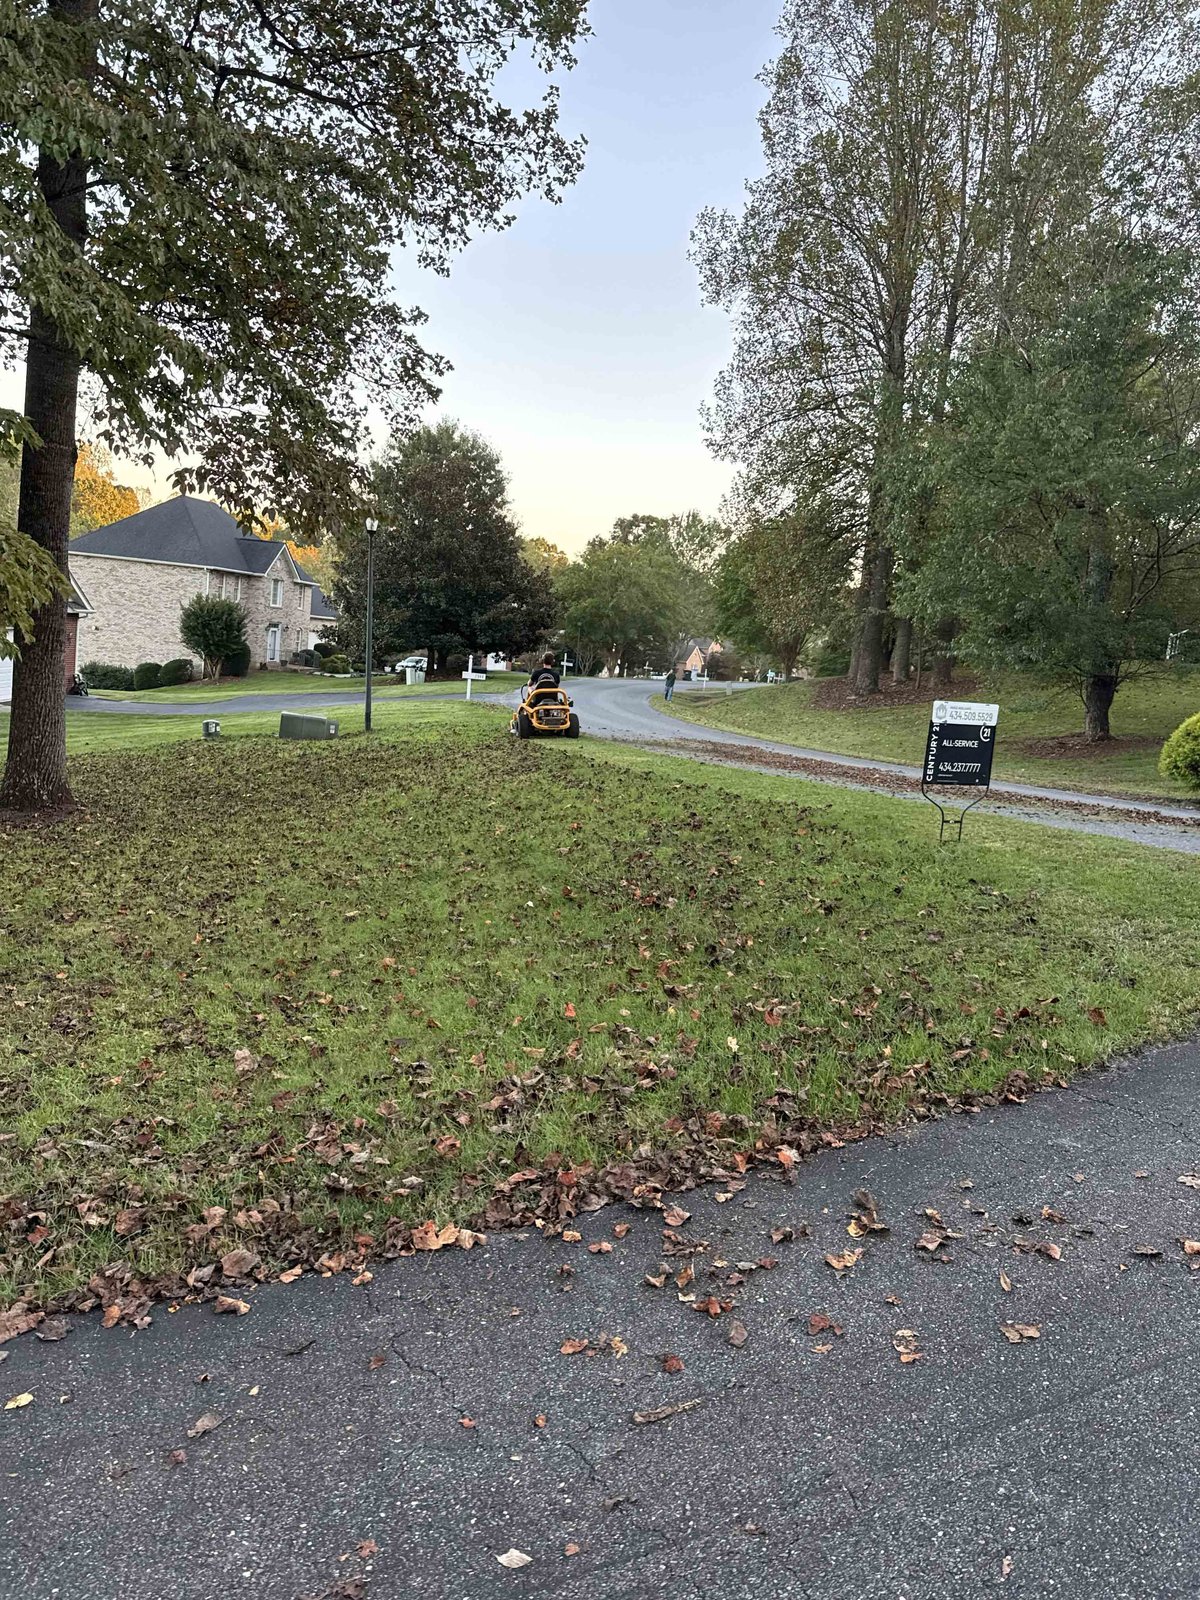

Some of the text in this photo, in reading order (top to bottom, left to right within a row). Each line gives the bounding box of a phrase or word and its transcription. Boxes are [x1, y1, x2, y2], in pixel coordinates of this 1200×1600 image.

[949, 710, 993, 722] 434.509.5529
[942, 739, 979, 748] ALL-SERVICE
[926, 723, 941, 782] CENTURY 21
[939, 762, 981, 773] 434.237.7777
